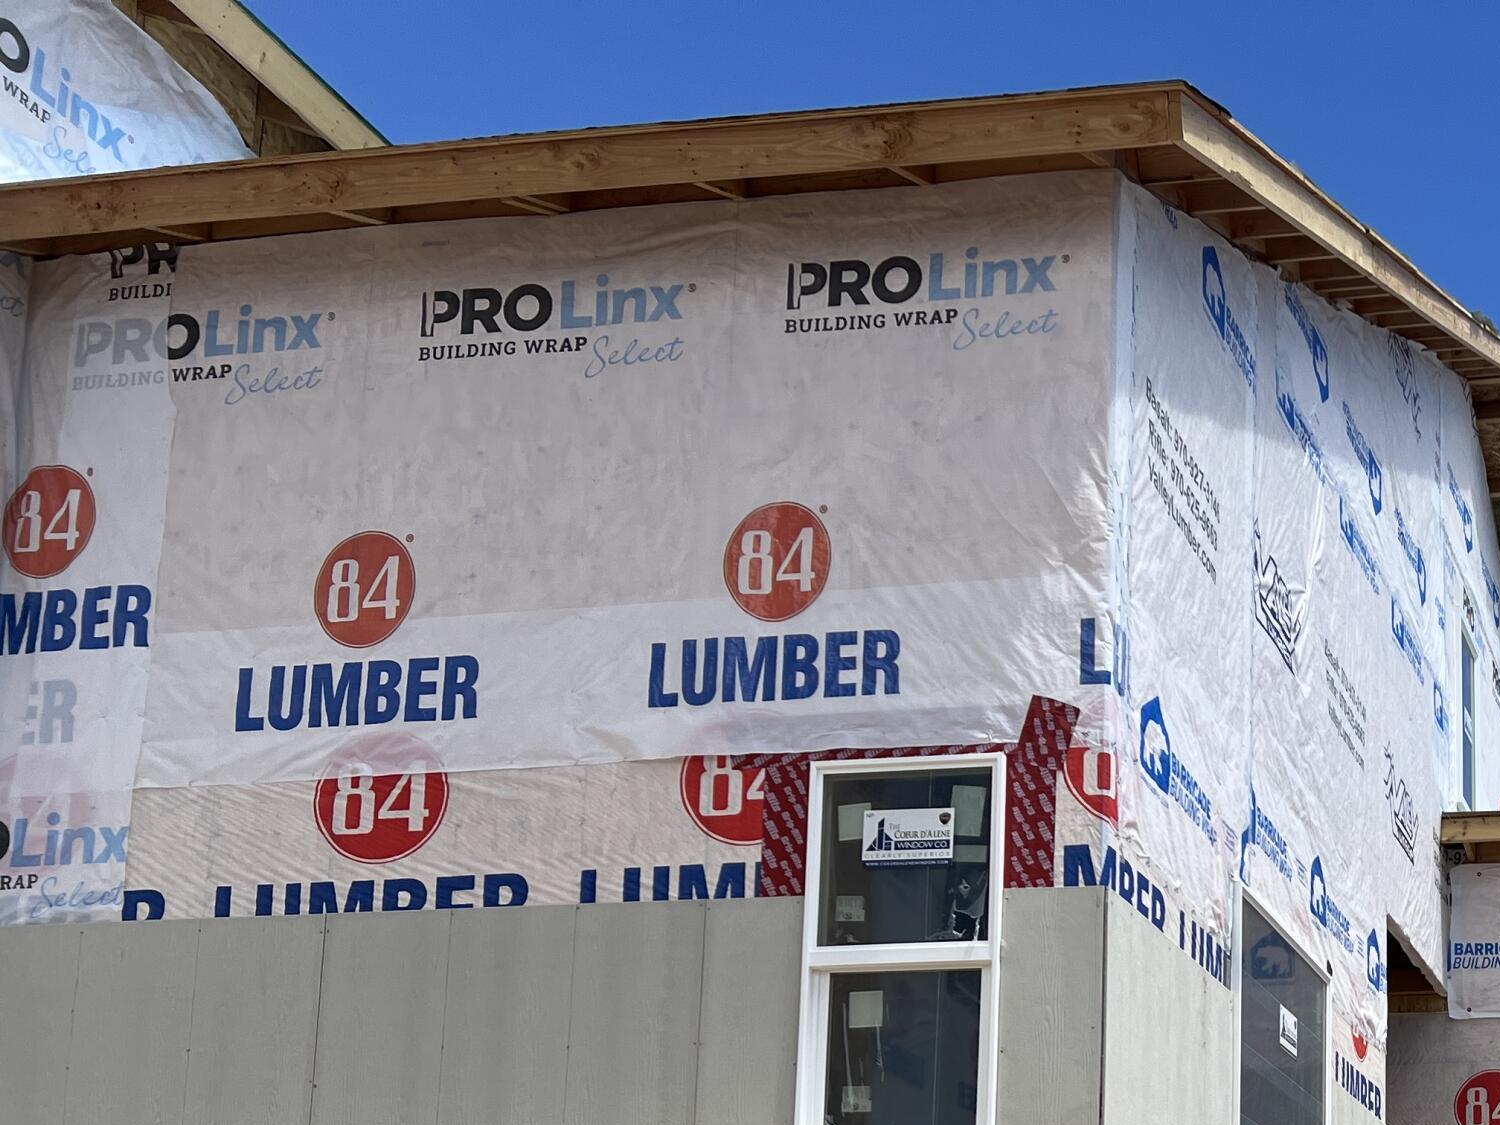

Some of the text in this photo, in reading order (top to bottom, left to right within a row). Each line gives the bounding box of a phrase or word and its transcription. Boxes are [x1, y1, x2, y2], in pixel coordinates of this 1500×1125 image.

[3, 75, 51, 125] WRAP
[108, 283, 172, 301] BUILDI
[418, 336, 685, 378] BUILDING WRAP Select
[784, 308, 1058, 350] BUILDING WRAP Select
[72, 364, 323, 405] BUILDING WRAP Select
[1146, 376, 1173, 441] Basalt:
[1148, 418, 1169, 470] Rifle:
[13, 489, 83, 553] 84
[327, 556, 401, 623] 84
[737, 526, 816, 596] 84
[234, 655, 480, 732] LUMBER
[647, 629, 901, 708] LUMBER
[332, 760, 430, 835] 84
[896, 840, 933, 848] WINDOW
